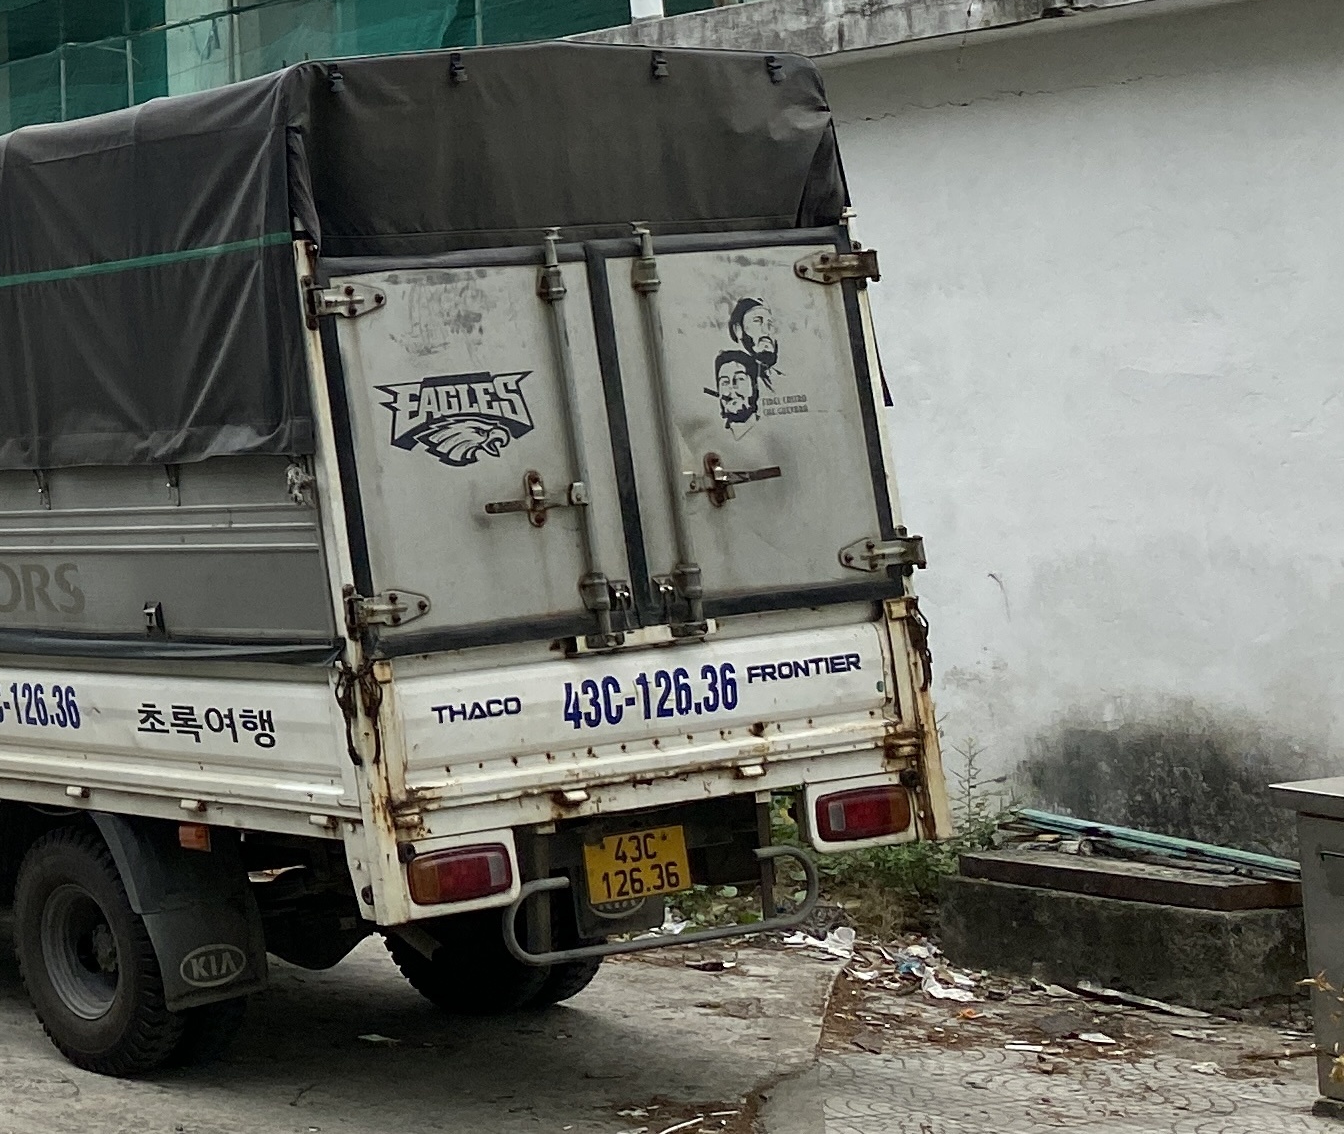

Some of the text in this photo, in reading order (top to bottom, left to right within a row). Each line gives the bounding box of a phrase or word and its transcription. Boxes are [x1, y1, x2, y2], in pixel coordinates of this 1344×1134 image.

[373, 371, 534, 446] EAGLES
[746, 653, 862, 684] FRONTIER
[431, 697, 522, 724] THACO
[563, 662, 739, 729] 43C-126.36
[137, 702, 277, 749] 초록여행
[614, 833, 658, 864] 43C
[601, 861, 680, 900] 126.36
[189, 951, 238, 980] KIA
